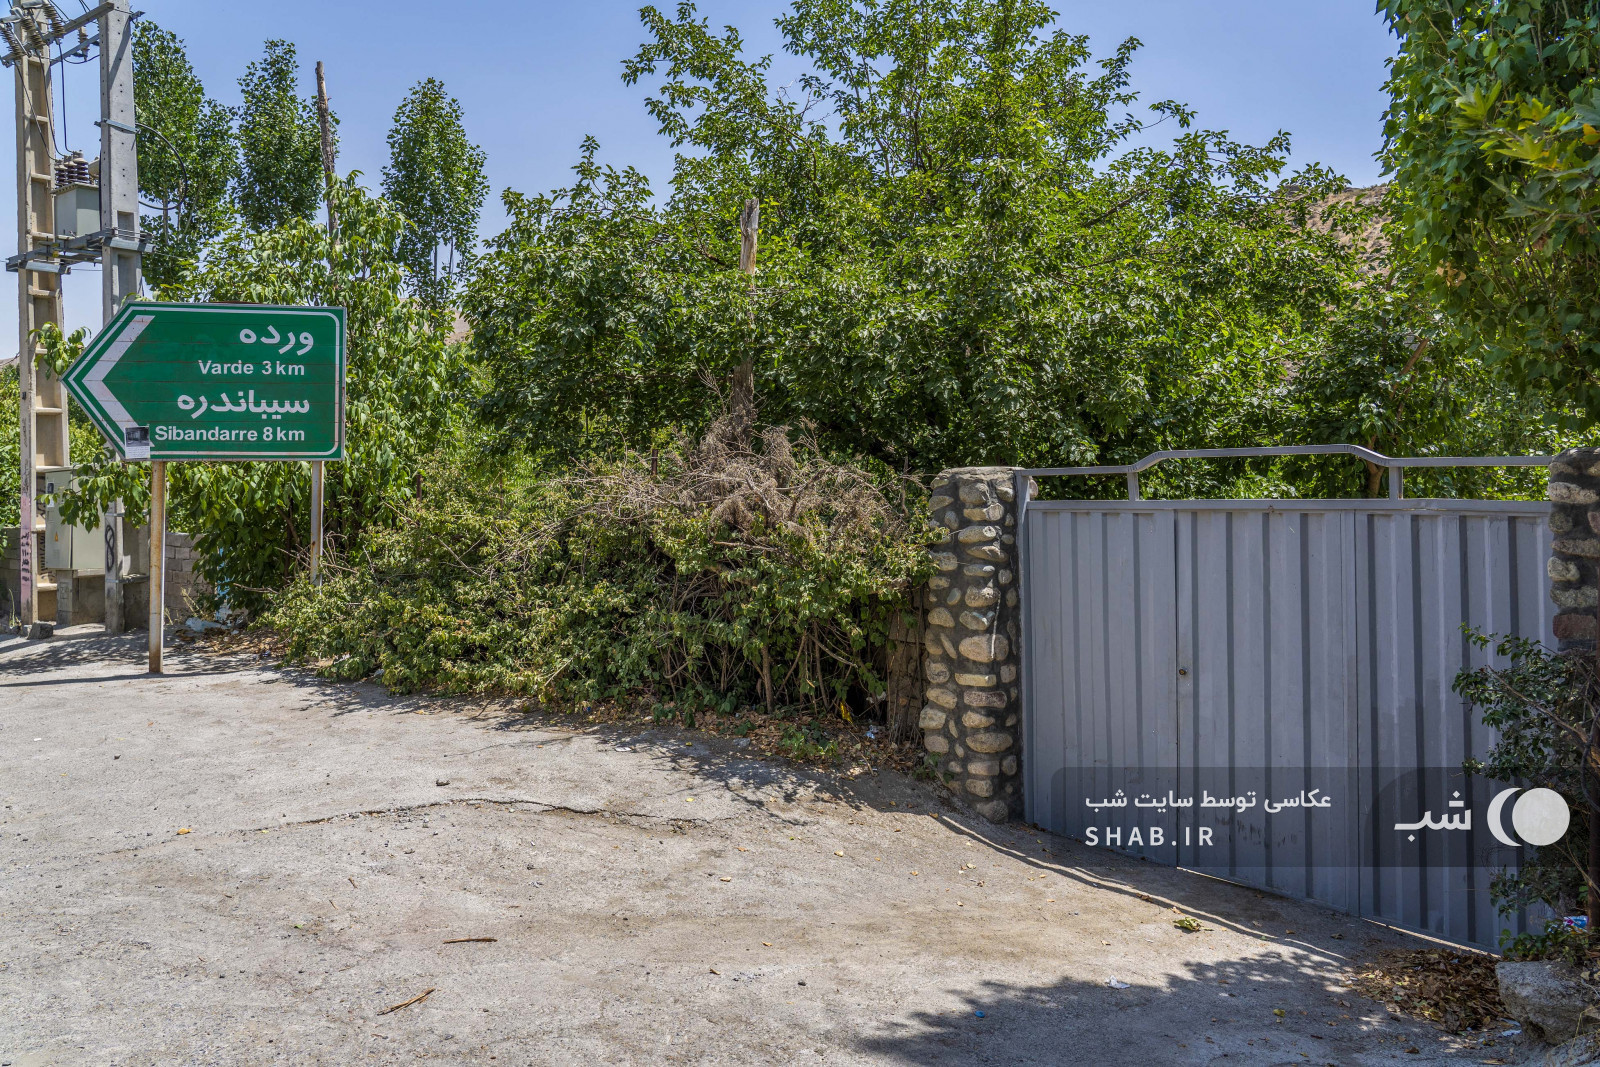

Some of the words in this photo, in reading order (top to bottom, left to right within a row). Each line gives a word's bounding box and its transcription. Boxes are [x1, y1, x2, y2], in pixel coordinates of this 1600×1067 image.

[239, 325, 314, 356] ورده
[198, 359, 254, 375] Varde
[177, 389, 310, 419] سیباندره
[155, 425, 258, 442] Sibandarre
